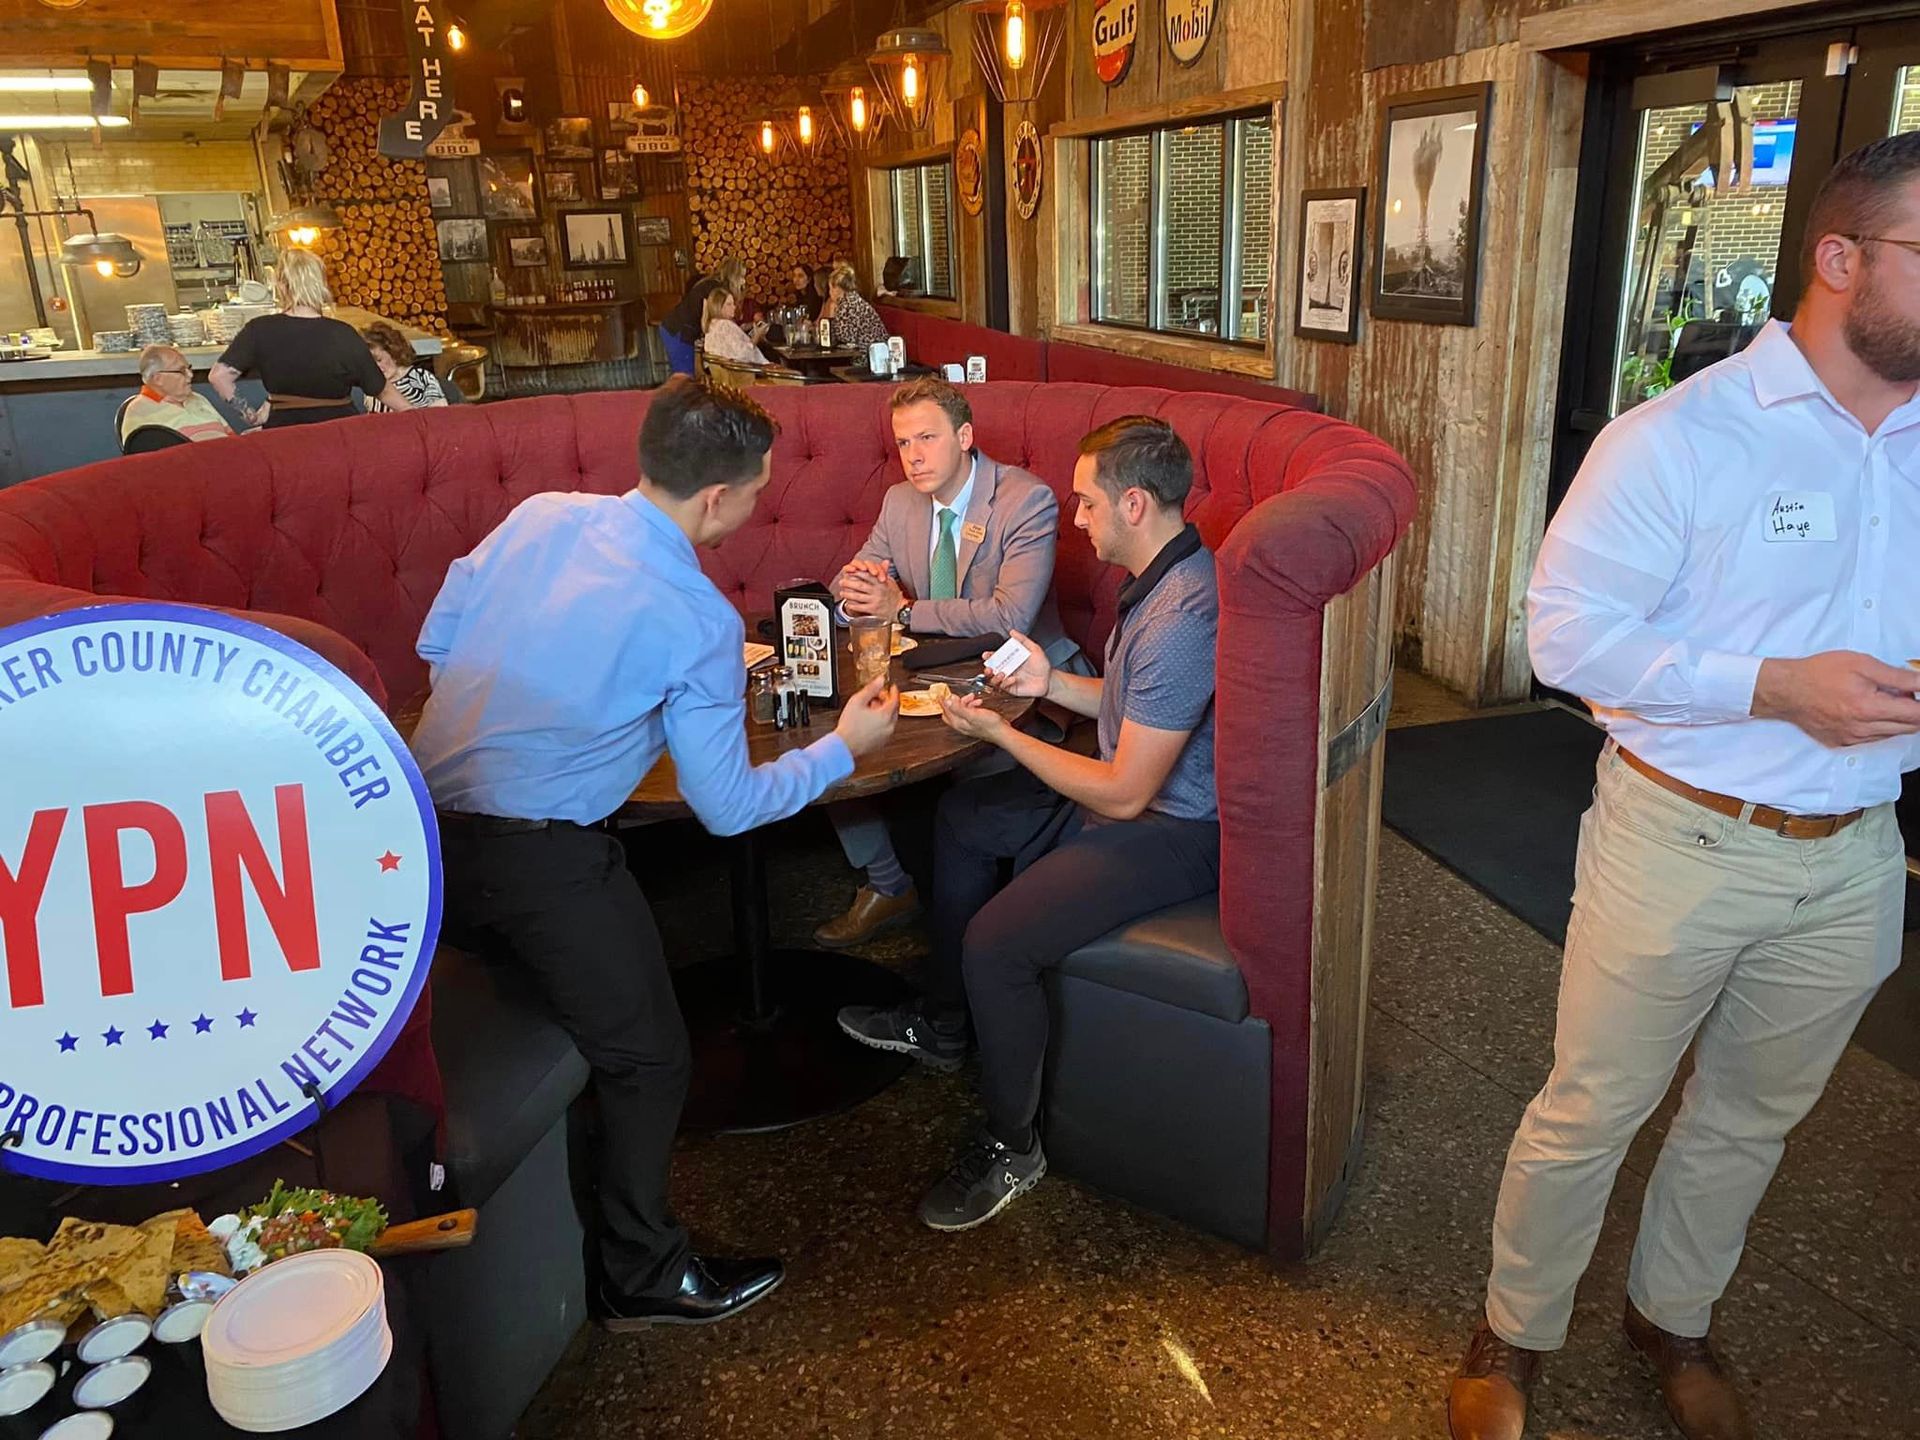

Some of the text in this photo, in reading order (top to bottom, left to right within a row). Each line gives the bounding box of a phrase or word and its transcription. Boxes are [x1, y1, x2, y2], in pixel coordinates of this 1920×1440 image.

[1095, 4, 1135, 46] Gulf
[1168, 5, 1209, 46] Mobil
[405, 0, 442, 141] AT HERE
[435, 145, 469, 154] BBQ
[637, 142, 670, 151] BBQ
[1771, 496, 1805, 516] Austin
[789, 602, 820, 611] BRUNCH
[72, 631, 240, 683] COUNTY
[242, 658, 391, 810] CHAMBER
[0, 783, 321, 1008] YPN
[280, 916, 411, 1091] NETWORK
